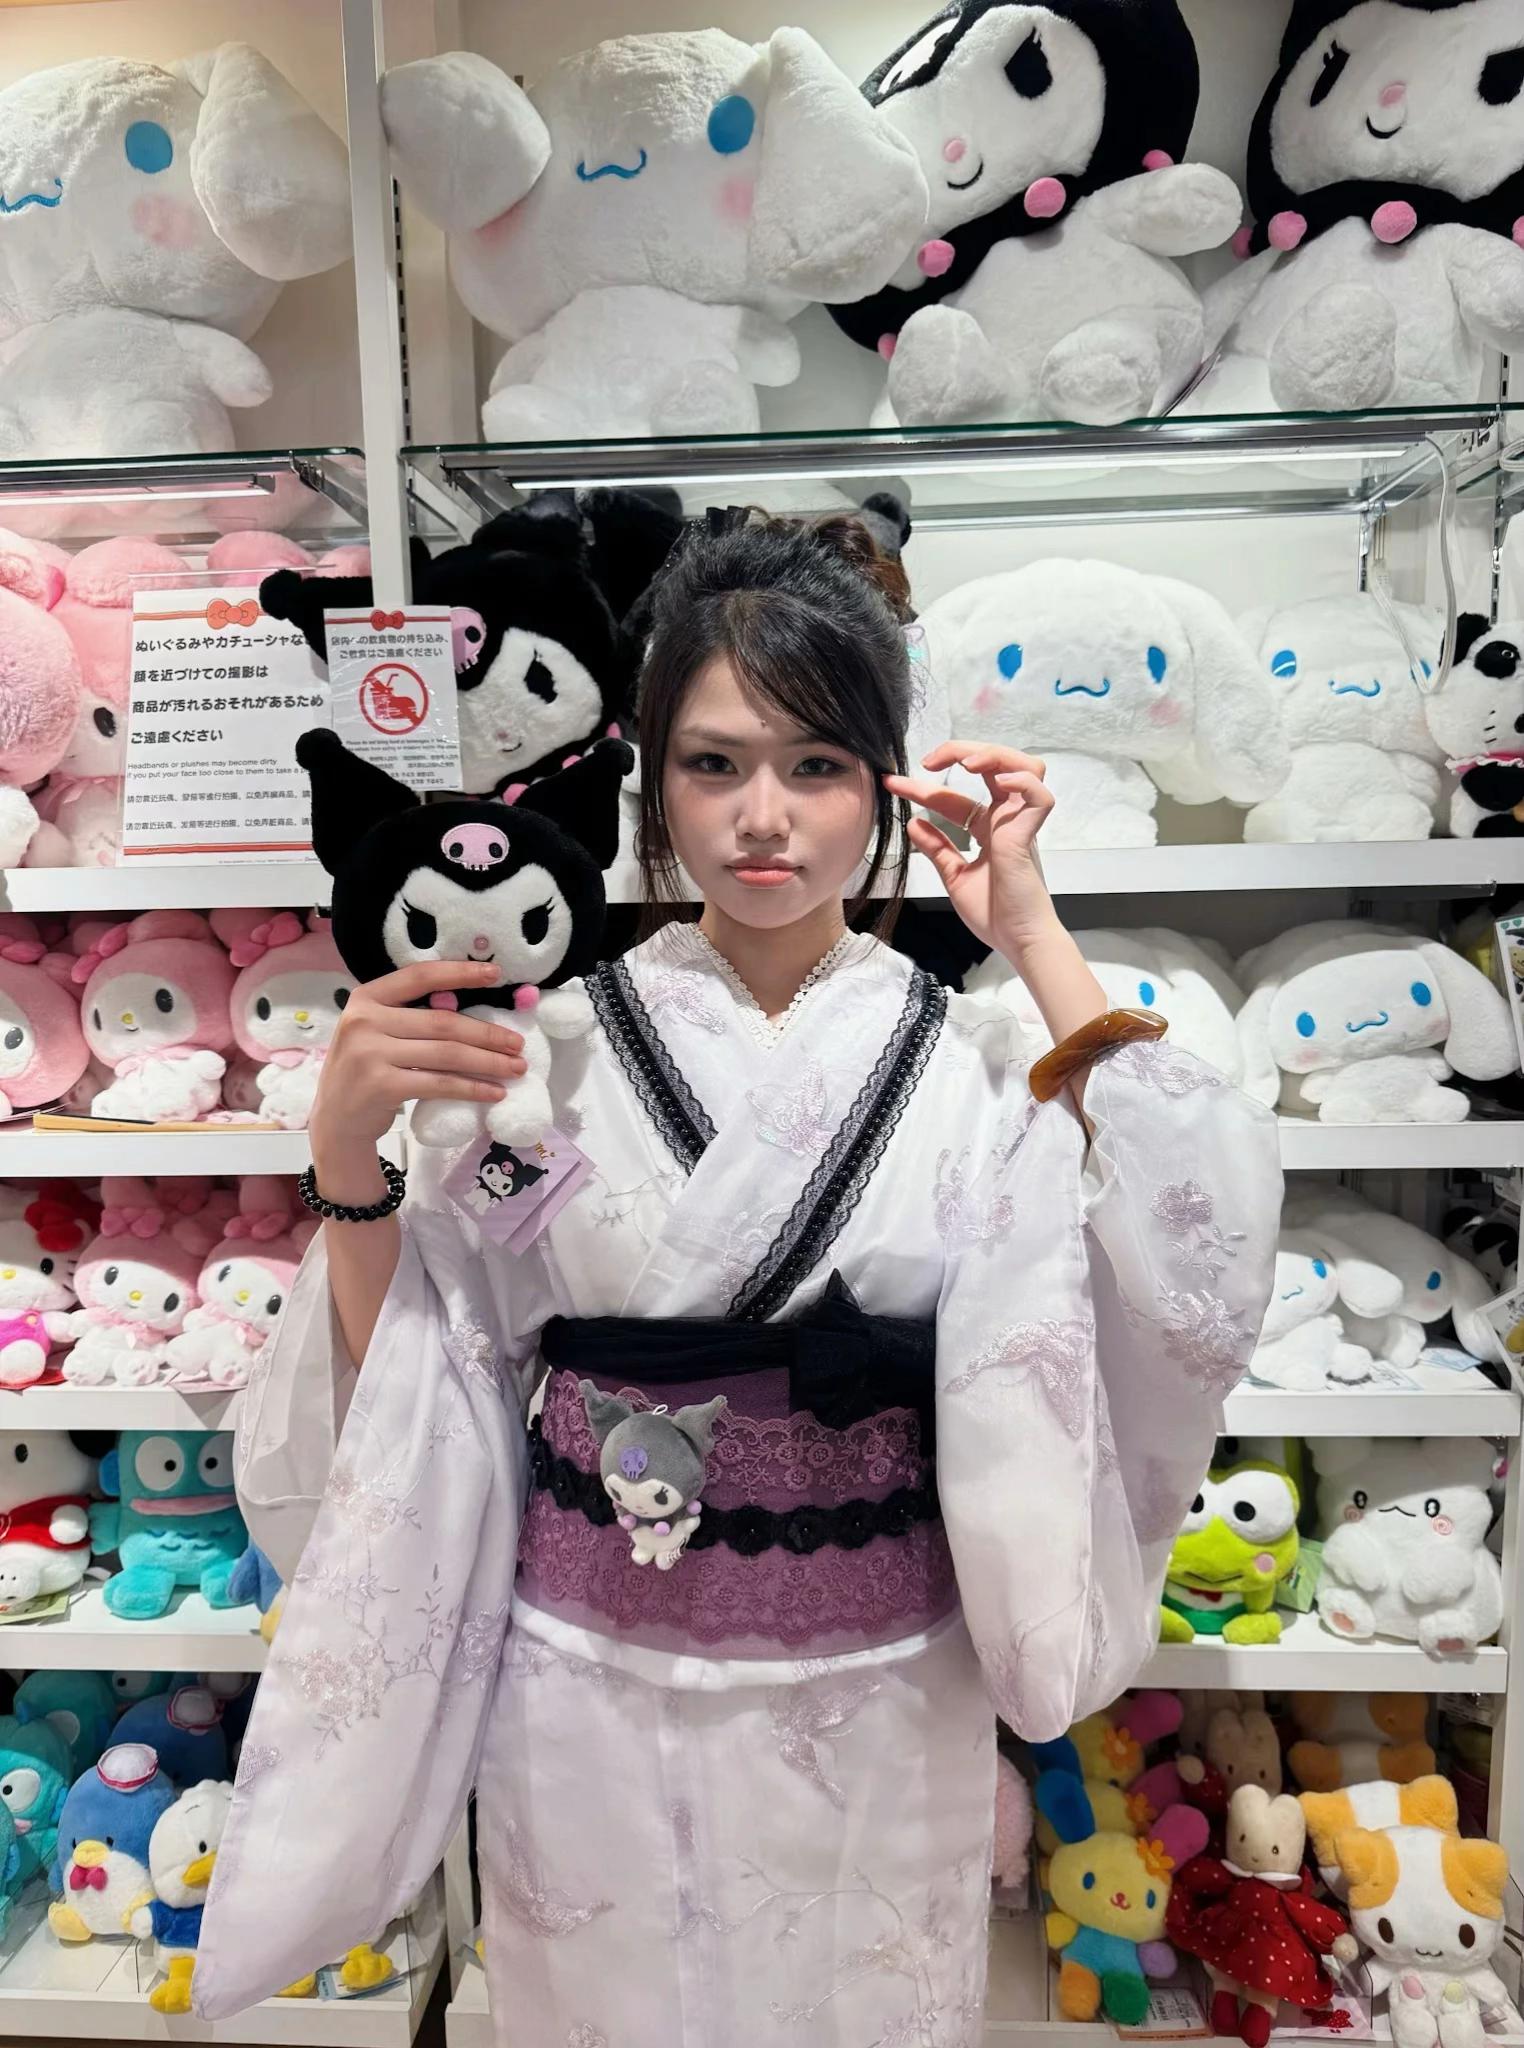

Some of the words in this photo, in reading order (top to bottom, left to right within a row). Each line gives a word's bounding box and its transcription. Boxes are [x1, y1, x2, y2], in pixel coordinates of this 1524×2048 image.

[135, 633, 309, 651] ぬいぐるみやカチューシャな
[133, 665, 268, 683] 顔を近づけての撮影は
[132, 695, 323, 713] 商品が汚れるおそれがあるため
[130, 729, 223, 745] ご遠慮ください
[127, 761, 169, 770] Headbands
[180, 760, 210, 770] plushes
[211, 761, 227, 769] may
[228, 759, 259, 767] become
[260, 758, 278, 767] dirty
[132, 772, 147, 781] you
[148, 771, 161, 780] put
[162, 771, 179, 780] your
[181, 769, 197, 777] face
